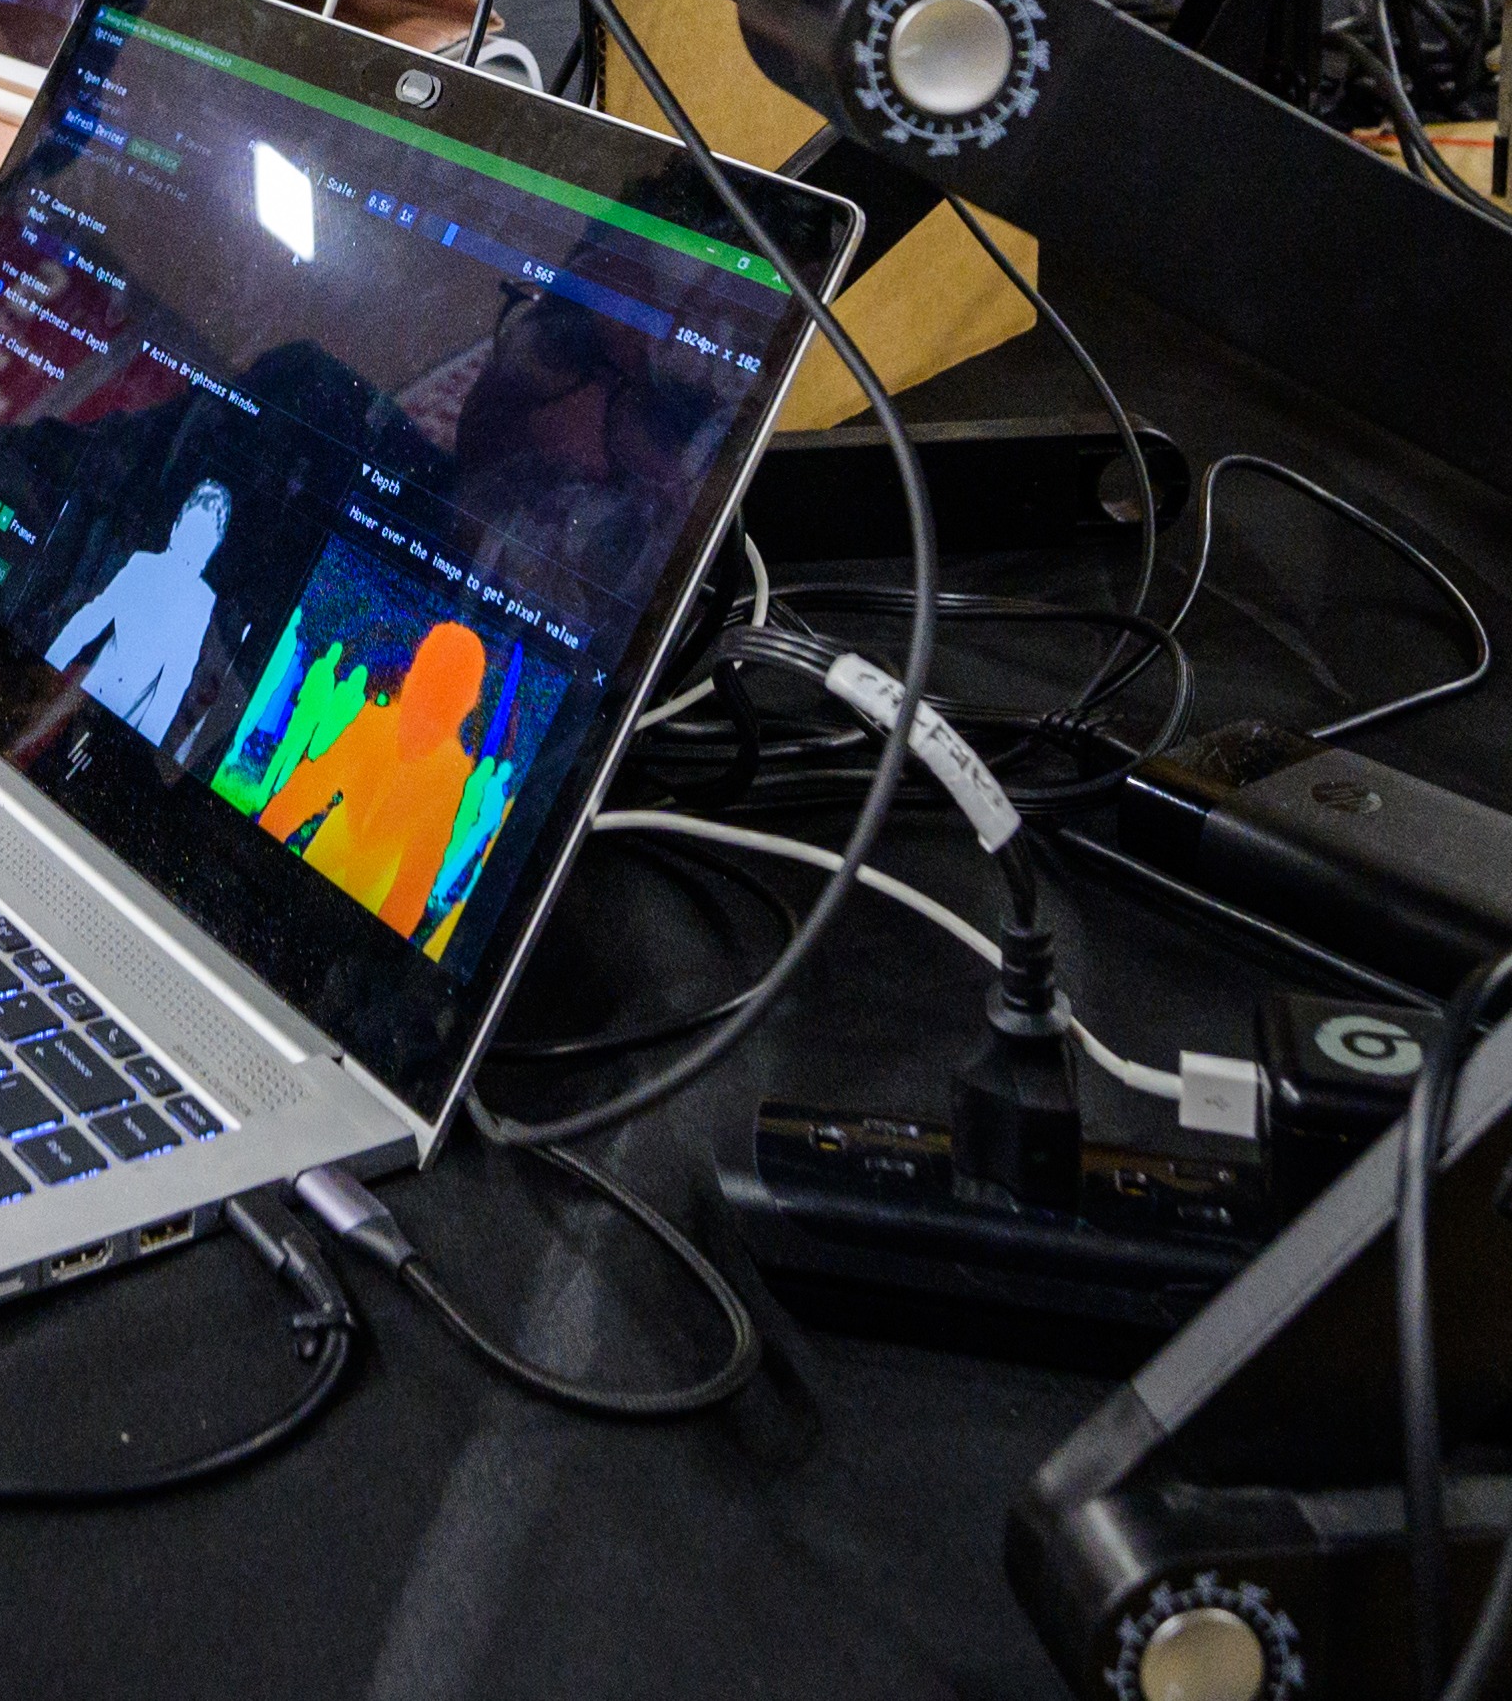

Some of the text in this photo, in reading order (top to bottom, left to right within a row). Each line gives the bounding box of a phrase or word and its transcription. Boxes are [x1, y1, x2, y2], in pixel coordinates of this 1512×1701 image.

[95, 26, 124, 47] Options
[83, 69, 128, 97] Open Device
[65, 110, 126, 146] Refresh Devices
[326, 176, 358, 199] Scale:
[28, 205, 49, 224] Mode:
[51, 198, 77, 220] Camera
[77, 211, 108, 235] Options
[367, 194, 392, 215] 0.5x
[399, 207, 414, 224] 1x
[1, 259, 52, 297] View Options:
[76, 255, 127, 291] Mode Options
[522, 260, 558, 285] 0.565
[3, 286, 110, 355] Active Brightness and Depth
[5, 336, 28, 359] Cloud
[28, 350, 43, 368] and
[42, 359, 65, 382] Depth
[675, 326, 762, 374] 1024px x 102
[149, 346, 261, 417] Active Brightness Window
[370, 469, 402, 497] Depth
[9, 518, 37, 546] Frames
[349, 505, 581, 650] Hover over the image to get pixel value
